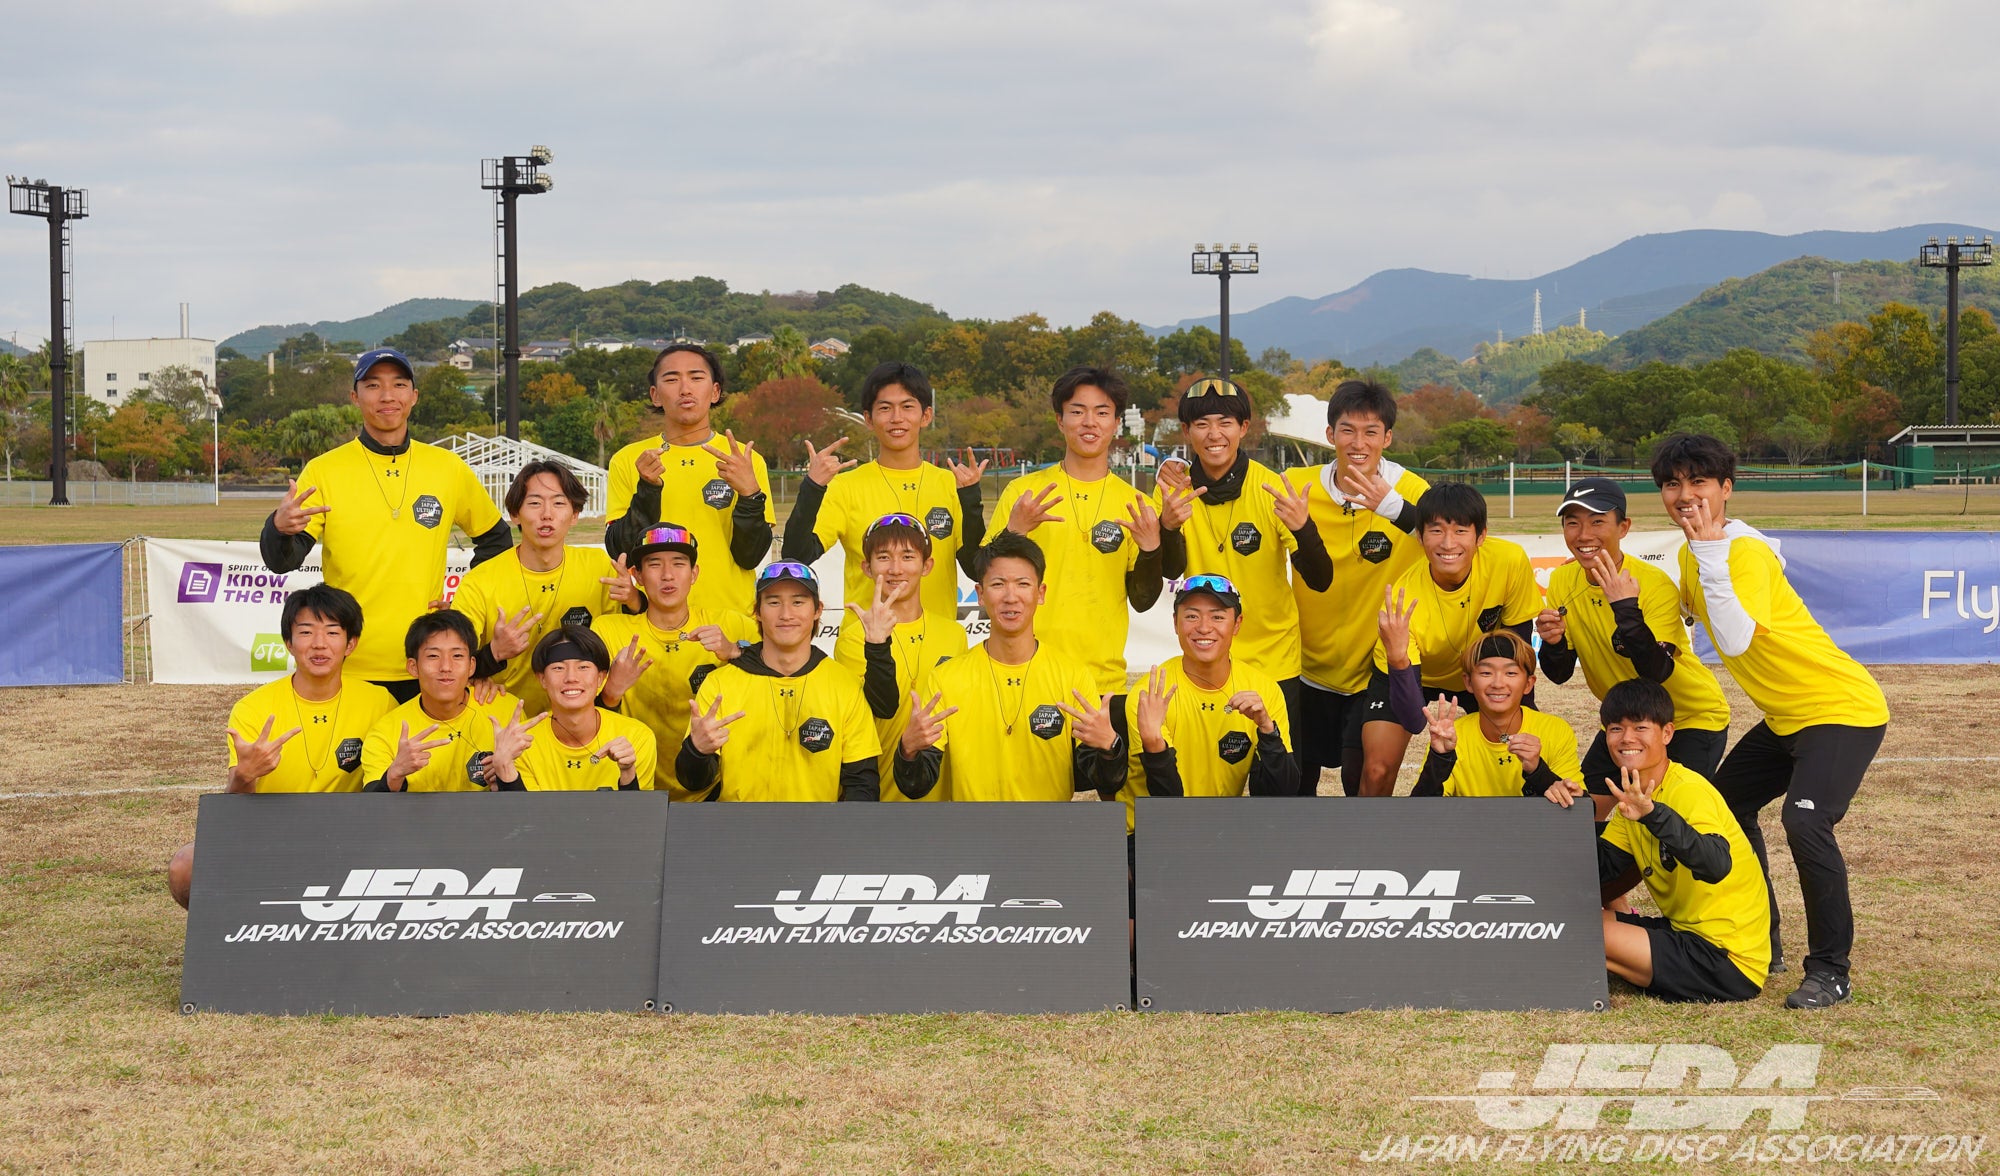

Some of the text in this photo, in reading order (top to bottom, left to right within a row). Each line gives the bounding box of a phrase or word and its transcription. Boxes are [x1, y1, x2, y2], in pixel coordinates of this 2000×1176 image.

[1640, 552, 1665, 561] ame:
[300, 868, 523, 921] JFDA
[774, 874, 990, 924] JFDA
[1247, 870, 1461, 919] JFDA
[224, 921, 623, 942] JAPAN FLYING DISC ASSOCIATION
[701, 926, 1092, 944] JAPAN FLYING DISC ASSOCIATION
[1178, 921, 1565, 939] JAPAN FLYING DISC ASSOCIATION
